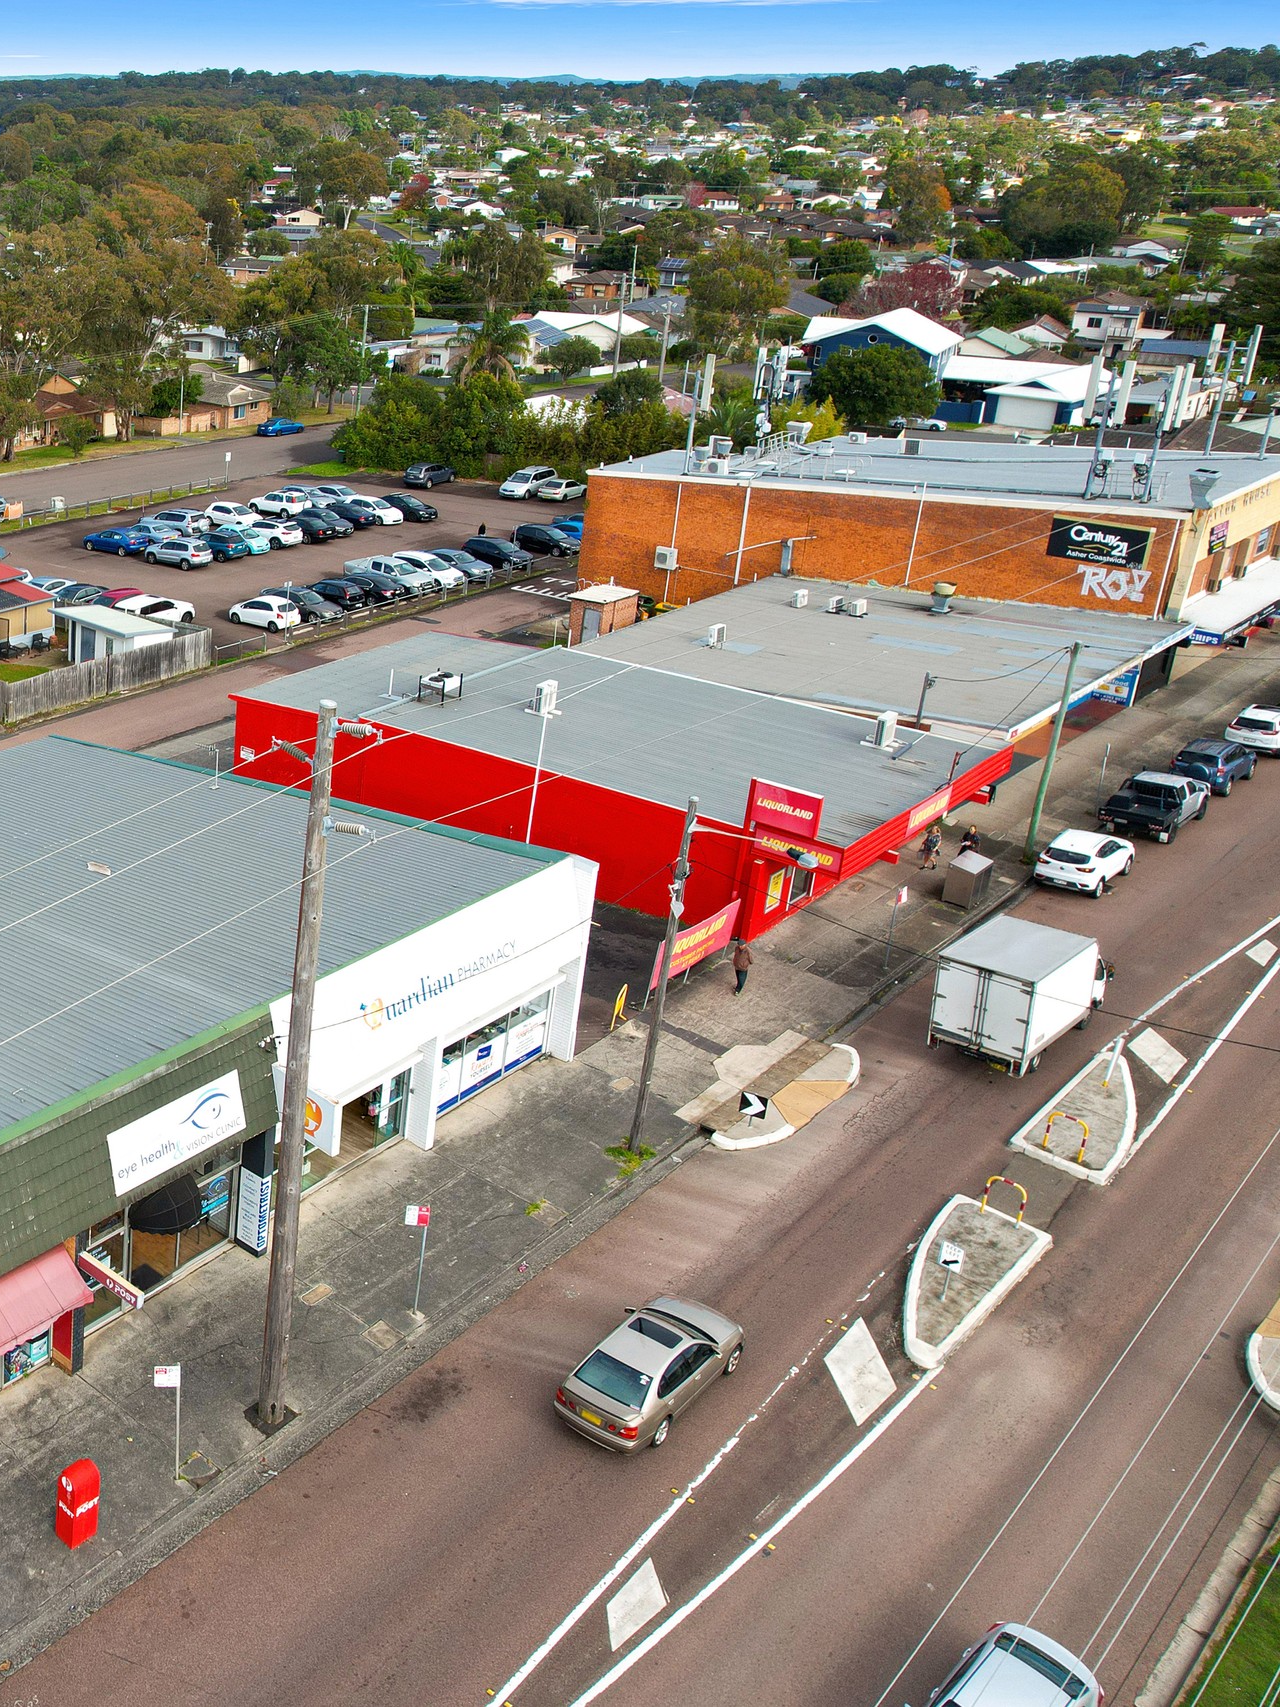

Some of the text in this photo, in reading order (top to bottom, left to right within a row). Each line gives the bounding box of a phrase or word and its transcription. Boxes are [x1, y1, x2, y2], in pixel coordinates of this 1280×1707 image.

[1070, 525, 1128, 557] Century 21
[1066, 549, 1126, 565] Asher Coastwide
[1189, 633, 1219, 645] CHIPS
[756, 797, 814, 821] LIQUORLAND
[671, 913, 728, 956] IQUORLAND
[363, 939, 517, 1031] Guardian PHARMACY
[117, 1162, 138, 1180] eye
[140, 1139, 176, 1167] health
[186, 1132, 214, 1152] VISION
[215, 1116, 242, 1138] CLINIC
[256, 1180, 270, 1249] OPTOMETRIST
[114, 1284, 136, 1304] POST
[58, 1499, 75, 1519] POST
[75, 1495, 100, 1518] POST
